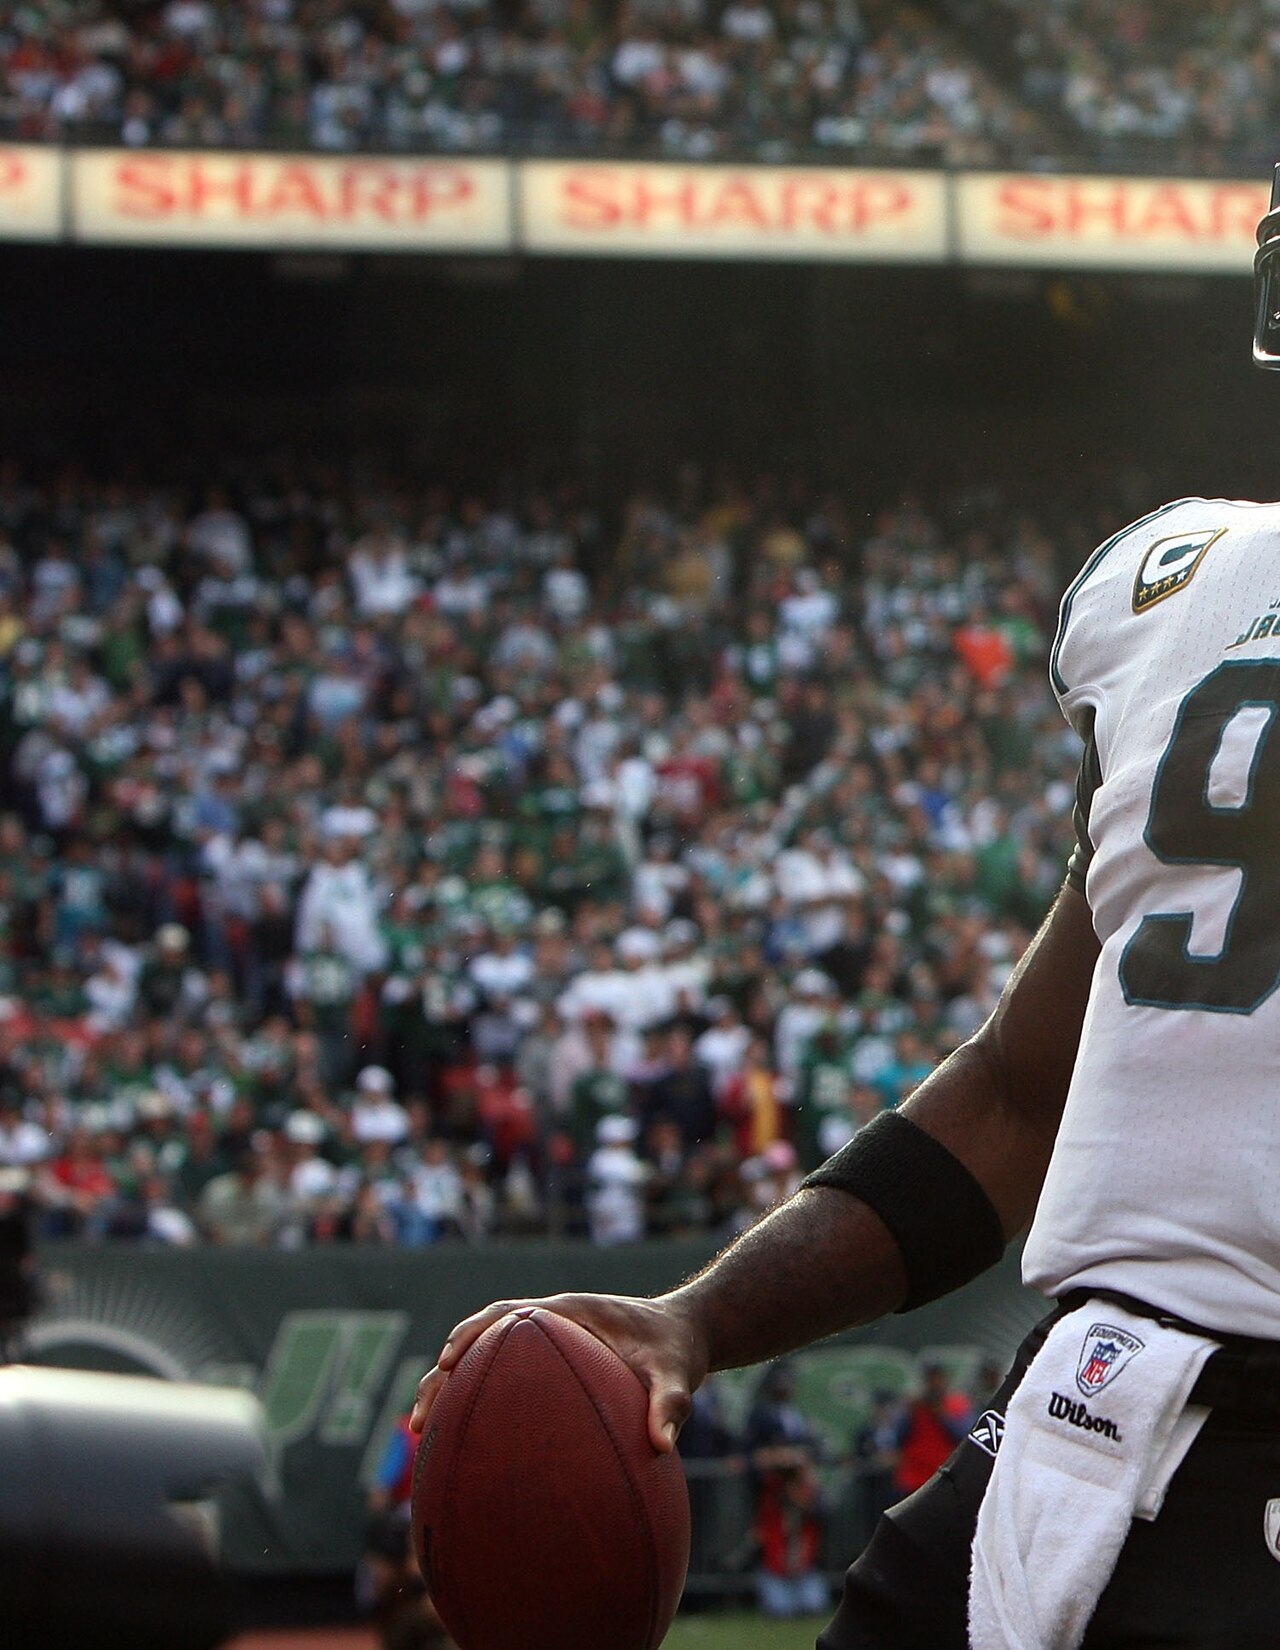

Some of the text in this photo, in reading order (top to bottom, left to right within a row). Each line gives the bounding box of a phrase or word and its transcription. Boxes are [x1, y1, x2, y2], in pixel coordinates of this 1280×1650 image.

[114, 154, 475, 225] SHARP
[560, 167, 912, 236] SHARP
[997, 178, 1270, 243] SHAR
[1089, 1326, 1140, 1353] EQUIPMENT
[1082, 1360, 1112, 1386] NFL
[1048, 1391, 1119, 1442] Wilson
